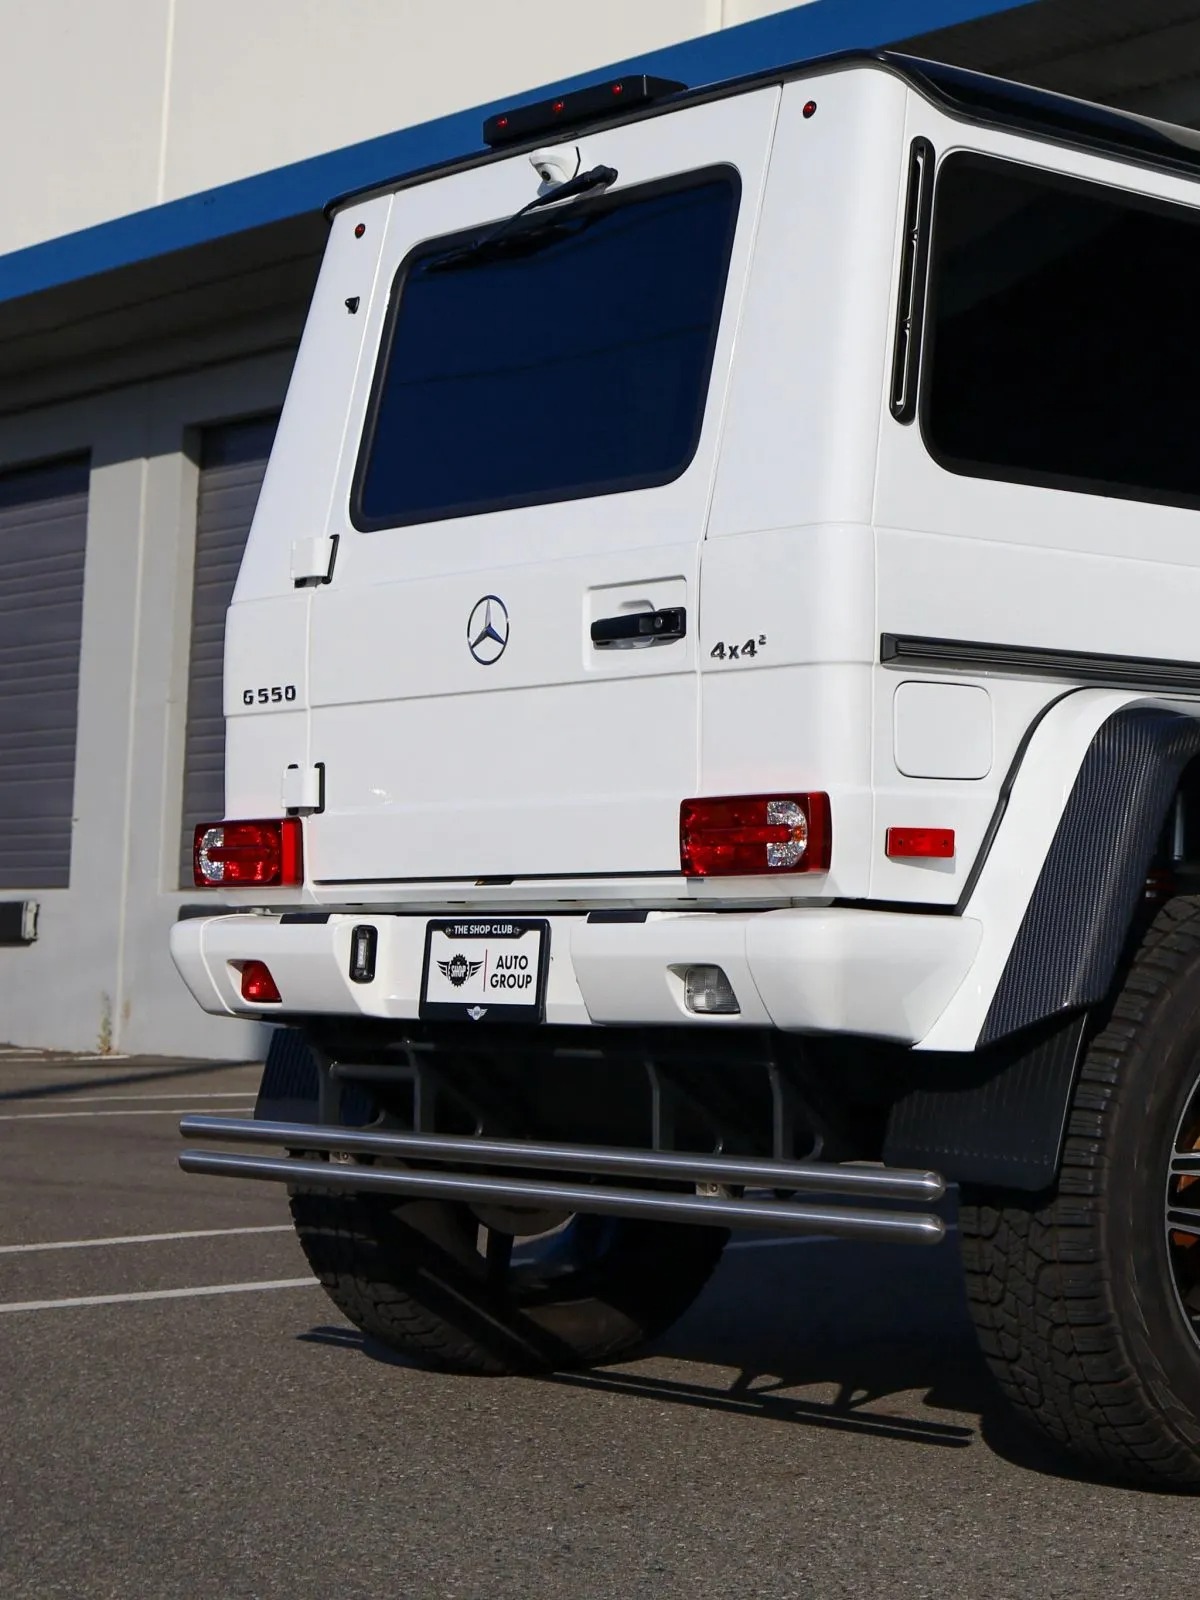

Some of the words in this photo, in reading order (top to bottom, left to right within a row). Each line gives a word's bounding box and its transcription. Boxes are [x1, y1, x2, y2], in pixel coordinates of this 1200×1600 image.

[454, 925, 468, 934] THE
[470, 925, 490, 934] SHOP
[491, 924, 513, 934] CLUB
[495, 955, 528, 970] AUTO
[490, 973, 532, 989] GROUP
